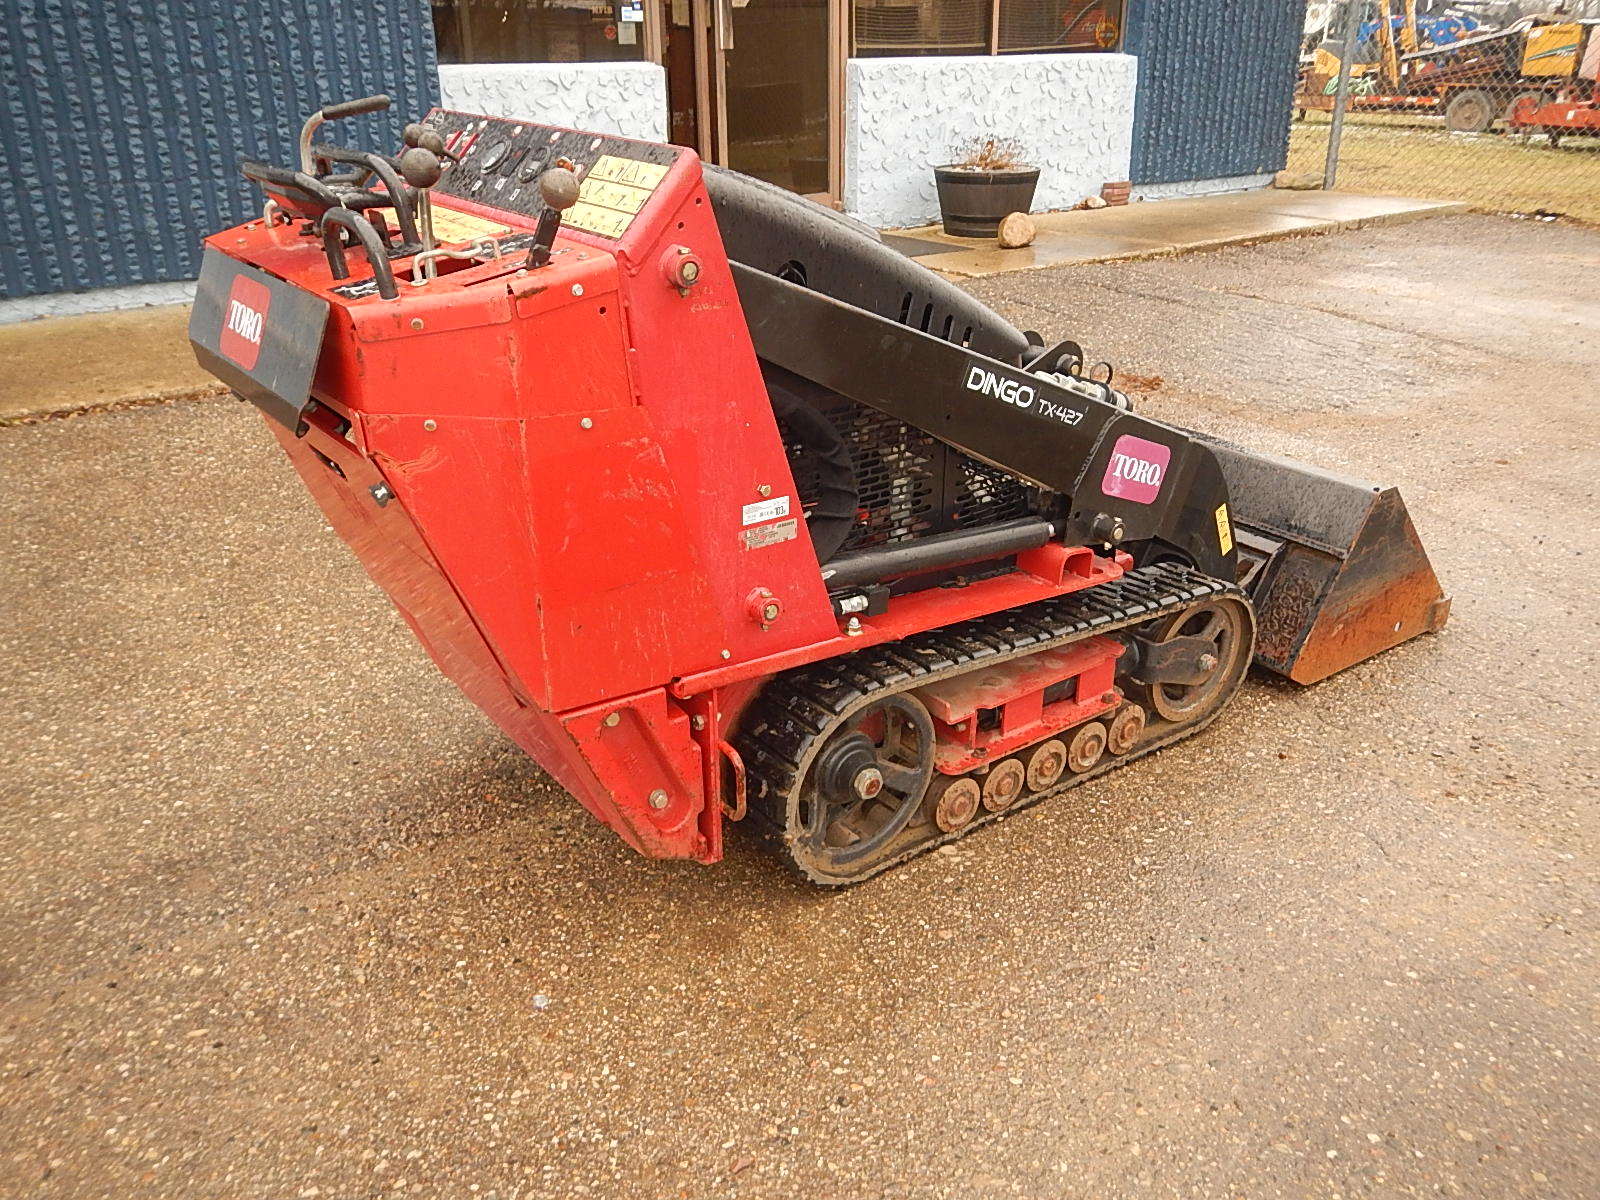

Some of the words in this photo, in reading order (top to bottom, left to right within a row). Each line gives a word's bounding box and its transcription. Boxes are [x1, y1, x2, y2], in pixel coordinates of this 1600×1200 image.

[228, 300, 262, 343] TORO
[966, 366, 1034, 408] DINGO
[1112, 454, 1161, 487] TORO
